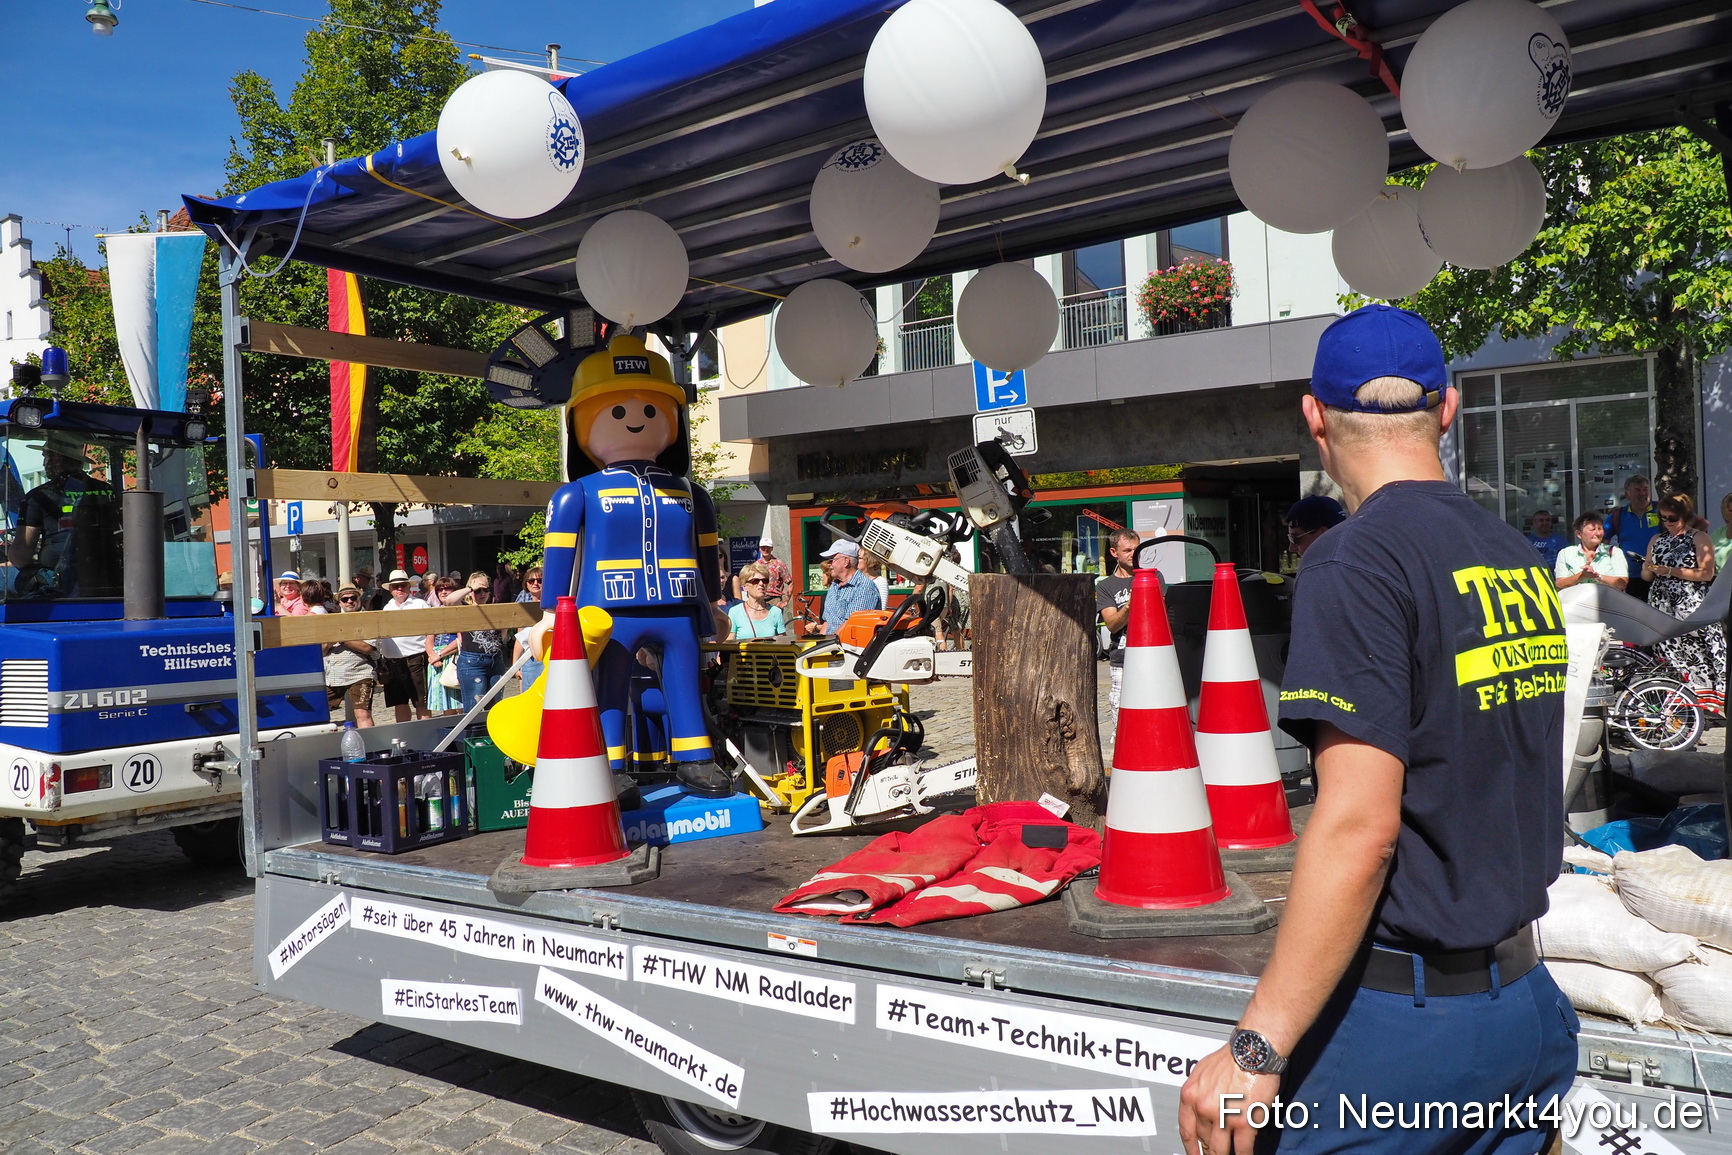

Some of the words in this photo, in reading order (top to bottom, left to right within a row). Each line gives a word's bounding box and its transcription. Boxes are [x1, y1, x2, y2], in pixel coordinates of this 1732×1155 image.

[615, 360, 648, 370] THW
[994, 416, 1012, 425] nur
[290, 506, 300, 531] P
[904, 535, 922, 548] STIHL
[413, 555, 427, 565] 50%
[1452, 565, 1566, 639] THW
[140, 642, 231, 657] Technisches
[164, 655, 232, 670] Hilfswerk
[98, 710, 135, 720] Serie
[138, 708, 148, 716] C
[1330, 696, 1356, 712] Chr.
[13, 764, 30, 792] 20
[129, 759, 155, 787] 20
[954, 767, 977, 781] STIH
[514, 799, 530, 808] Bis
[627, 808, 731, 841] playmobil
[279, 901, 347, 965] #Motorsägen
[363, 905, 398, 926] #seit
[403, 913, 434, 935] über
[439, 919, 457, 939] 45
[463, 923, 515, 950] Jahren
[522, 933, 536, 954] in
[542, 937, 624, 970] Neumarkt
[642, 953, 707, 985] #THW
[715, 967, 750, 995] NM
[758, 974, 852, 1012] Radlader
[394, 987, 519, 1016] #EinStarkesTeam
[543, 983, 738, 1099] www.thw-neumarkt.de
[887, 998, 1198, 1078] #Team+Technik+Ehren
[830, 1096, 1145, 1127] #Hochwasserschutz_NM
